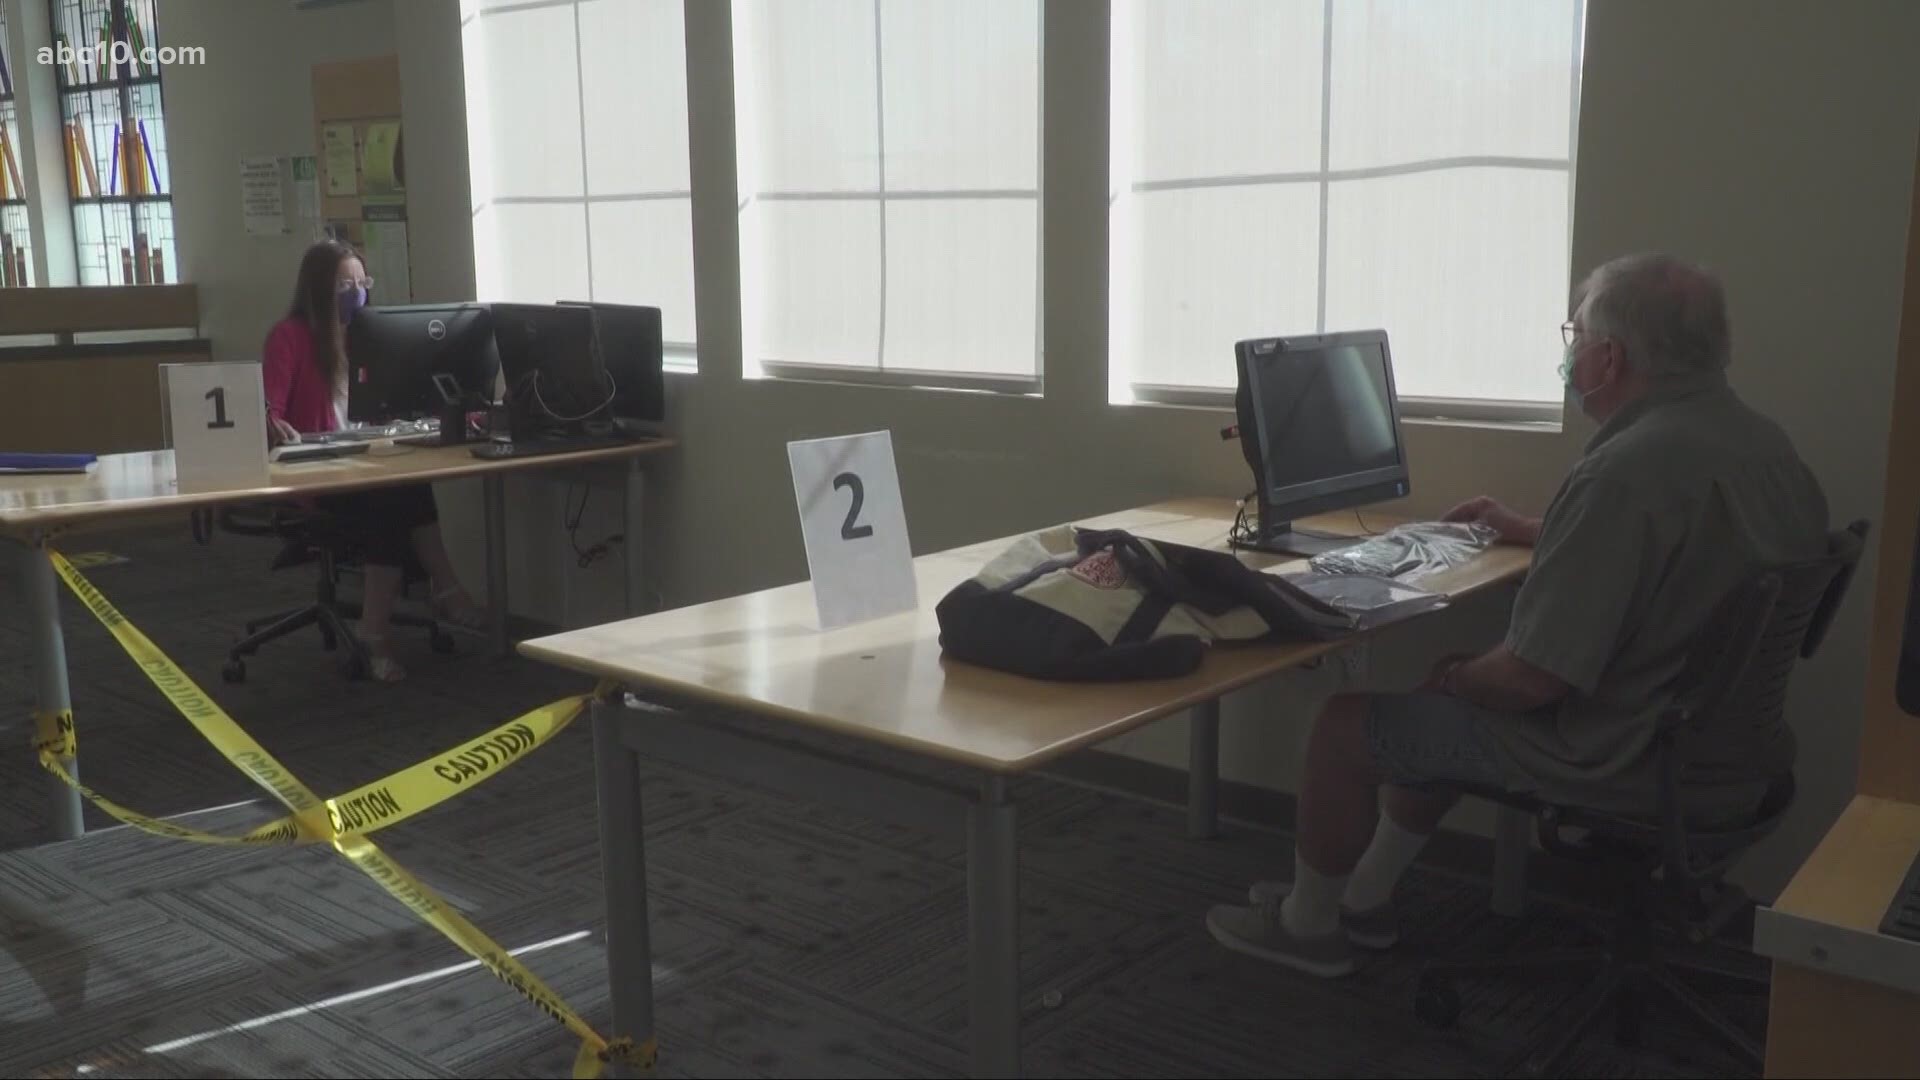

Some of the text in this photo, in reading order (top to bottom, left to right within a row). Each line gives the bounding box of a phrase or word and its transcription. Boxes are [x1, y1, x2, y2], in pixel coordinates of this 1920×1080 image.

[205, 387, 235, 429] 1
[833, 472, 873, 540] 2
[327, 722, 536, 834] CAUTION CAUTION
